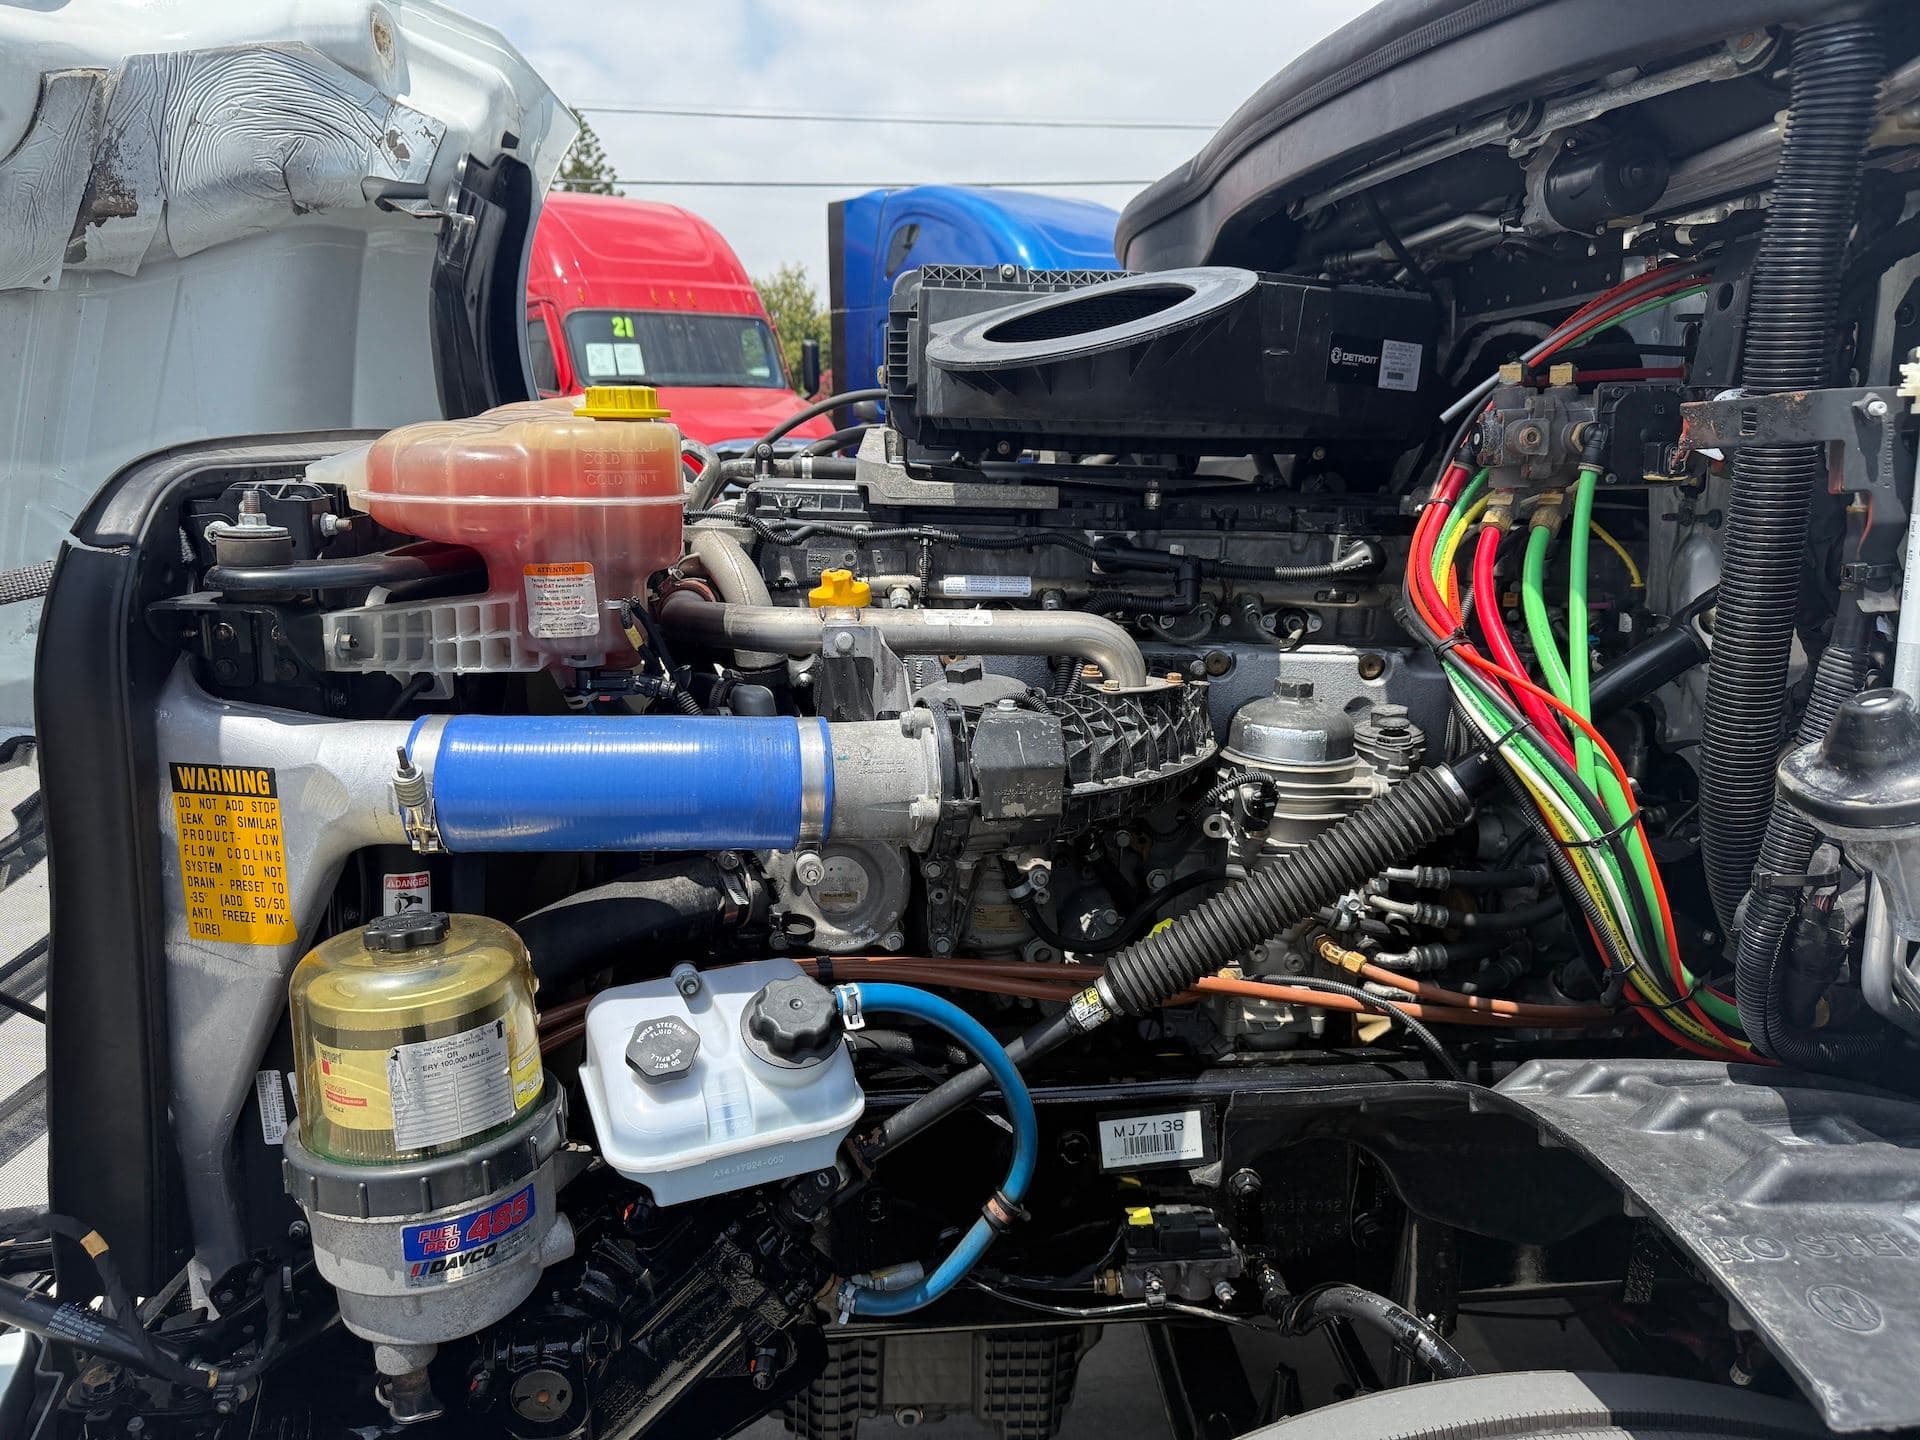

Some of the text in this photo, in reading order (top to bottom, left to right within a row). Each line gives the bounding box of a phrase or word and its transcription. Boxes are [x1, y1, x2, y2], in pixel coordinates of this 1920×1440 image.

[612, 317, 634, 337] 21
[1342, 353, 1378, 364] DETROIT
[177, 766, 270, 794] WARNING
[179, 797, 276, 812] DO NOT ADD STOP
[181, 813, 278, 830] LEAK OR SIMILAR
[255, 835, 279, 846] LOW
[184, 845, 281, 862] FLOW COOLING
[186, 860, 222, 874] SYSTEM
[242, 865, 255, 876] DO
[264, 866, 282, 878] NOT
[188, 876, 215, 888] DRAIN
[230, 880, 264, 893] PRESET
[272, 883, 284, 894] TO
[396, 877, 428, 887] DANGER
[220, 894, 242, 907] (ADD
[254, 897, 285, 910] 50/50
[192, 907, 289, 926] ANTI FREEZE MIX-
[637, 1022, 687, 1043] POWER STEERING
[650, 1029, 672, 1038] FLUID
[441, 1055, 467, 1068] 100,000
[469, 1048, 490, 1059] MILES
[651, 1049, 681, 1062] OVERFILL
[1114, 1120, 1184, 1138] MJ7138
[418, 1224, 461, 1243] FUEL
[466, 1191, 528, 1242] 485
[424, 1237, 460, 1255] PRO
[1700, 1234, 1789, 1263] NO
[429, 1242, 497, 1274] DAVCO
